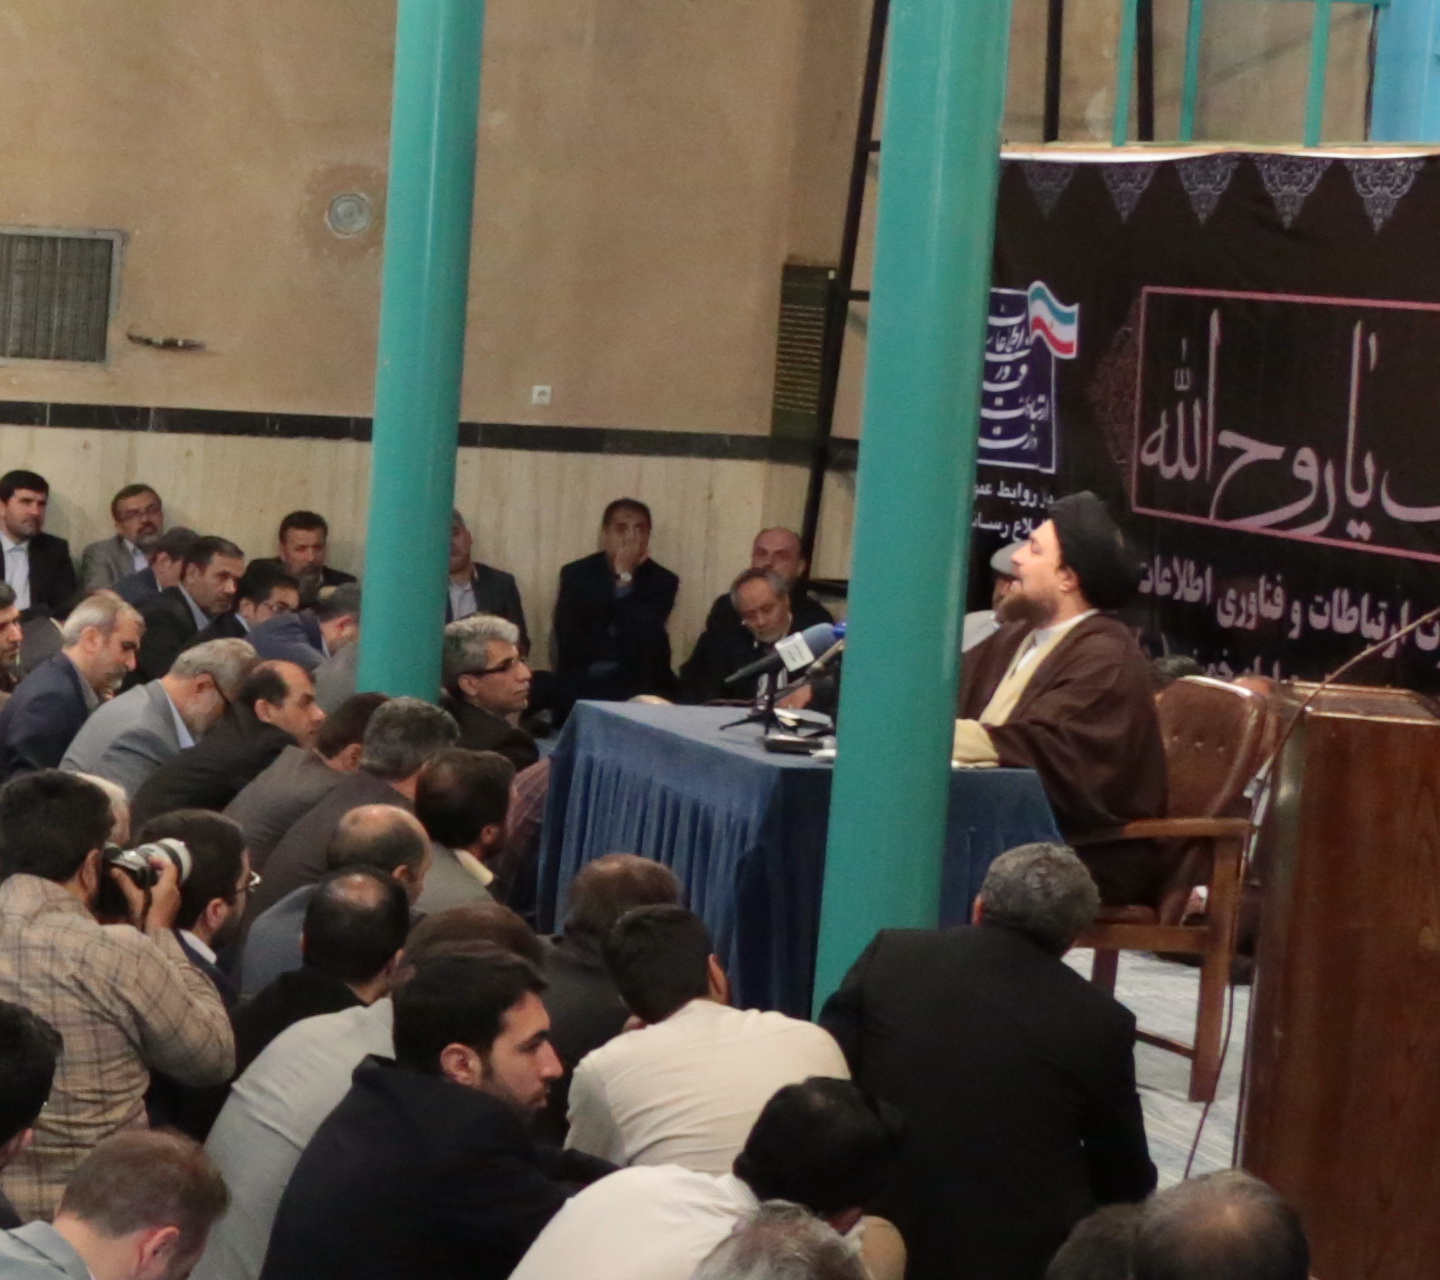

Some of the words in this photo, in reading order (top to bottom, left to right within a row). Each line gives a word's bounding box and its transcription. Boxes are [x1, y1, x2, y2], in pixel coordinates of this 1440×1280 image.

[1140, 308, 1221, 482] الله
[997, 480, 1038, 508] روابط
[1209, 429, 1337, 537] روح
[1216, 572, 1286, 631] فناوری
[1287, 599, 1302, 639] و
